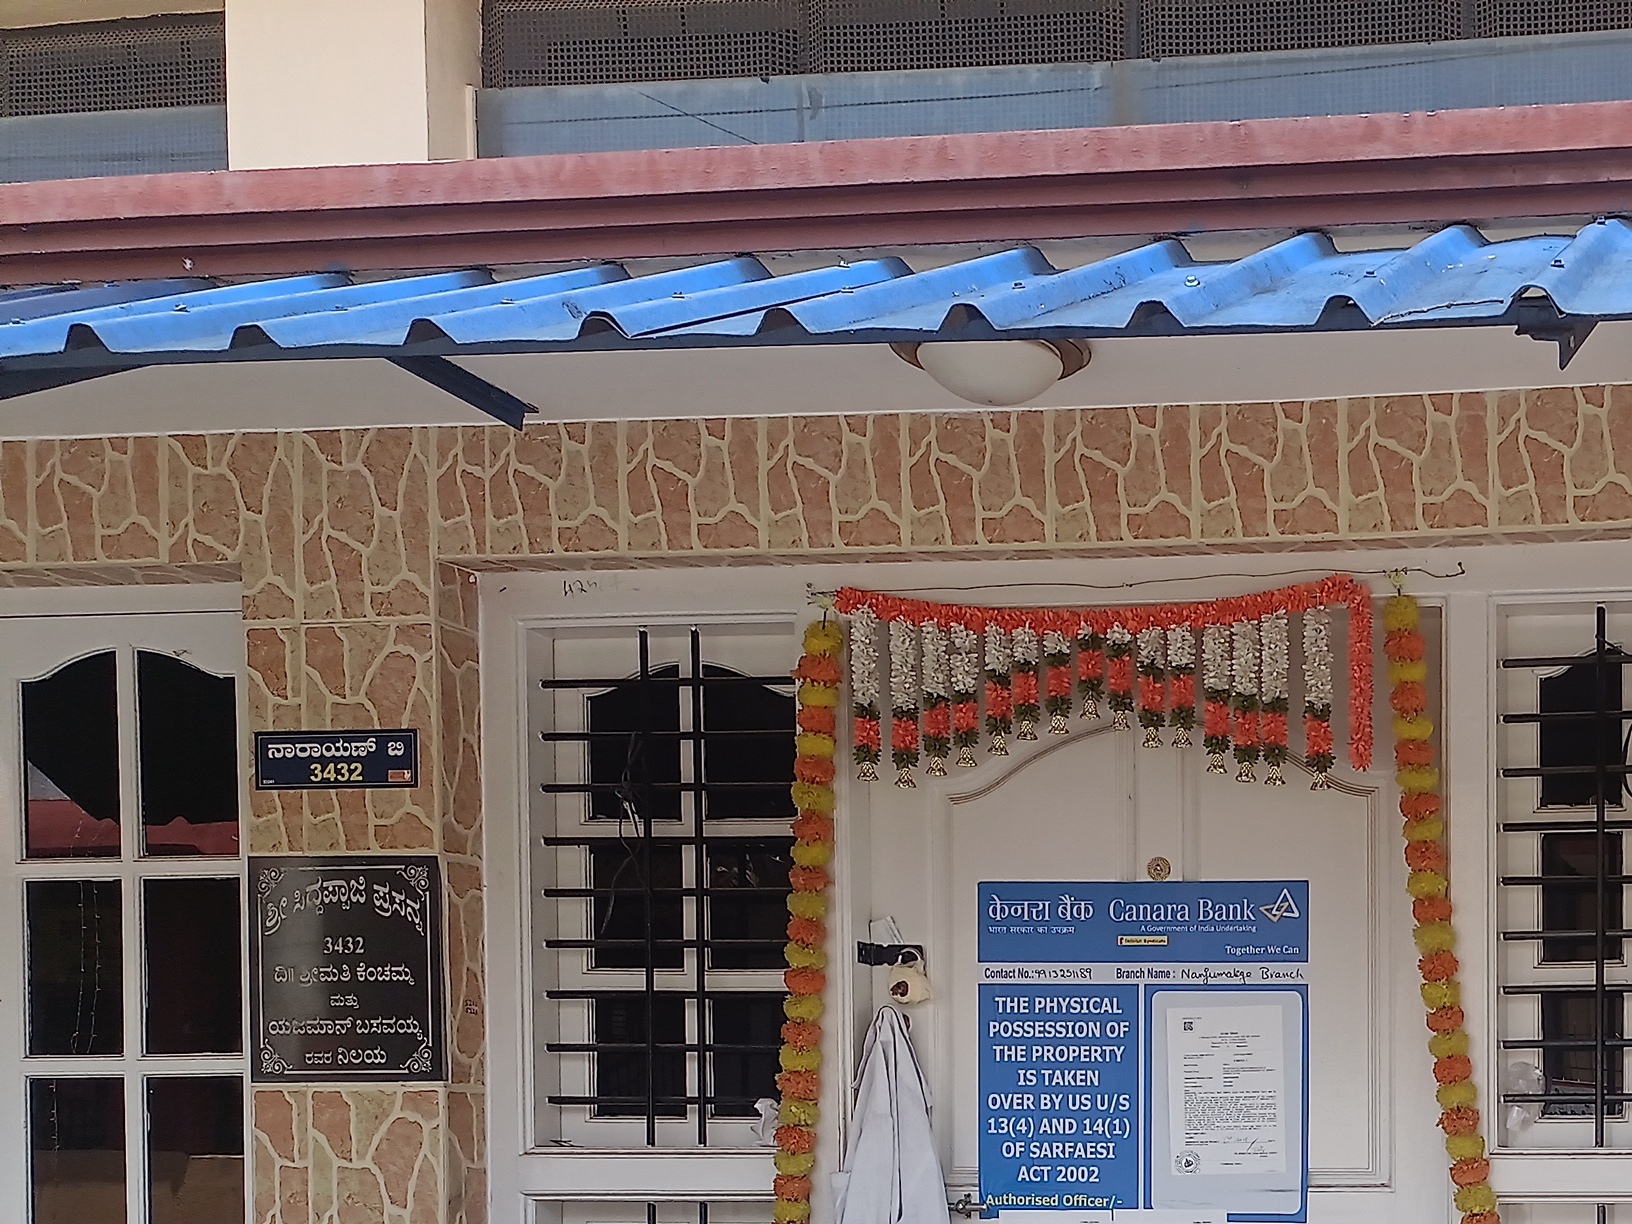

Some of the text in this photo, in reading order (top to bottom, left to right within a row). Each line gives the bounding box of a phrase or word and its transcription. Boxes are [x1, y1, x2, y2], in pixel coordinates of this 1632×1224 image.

[310, 763, 363, 782] 3432
[988, 893, 1095, 922] केनरा बैंक
[1108, 898, 1257, 922] Canara Bank
[1215, 925, 1257, 933] Undertaking
[323, 936, 365, 955] 3432
[1225, 945, 1300, 957] Together We Can
[984, 967, 1016, 980] Contact
[1116, 967, 1145, 980] Branch
[995, 997, 1123, 1014] THE PHYSICAL
[989, 1021, 1131, 1038] POSSESSION OF
[336, 1045, 388, 1065] ನಿಲಯ
[992, 1045, 1126, 1062] THE PROPERTY
[1017, 1069, 1100, 1086] IS TAKEN
[987, 1094, 1131, 1113] OVER BY US U/S
[987, 1118, 1131, 1139] 13(4) AND 14(1)
[1001, 1142, 1116, 1159] OF SARFAESI
[1017, 1166, 1100, 1183] ACT 2002
[986, 1194, 1124, 1209] Authorised Officer/-
